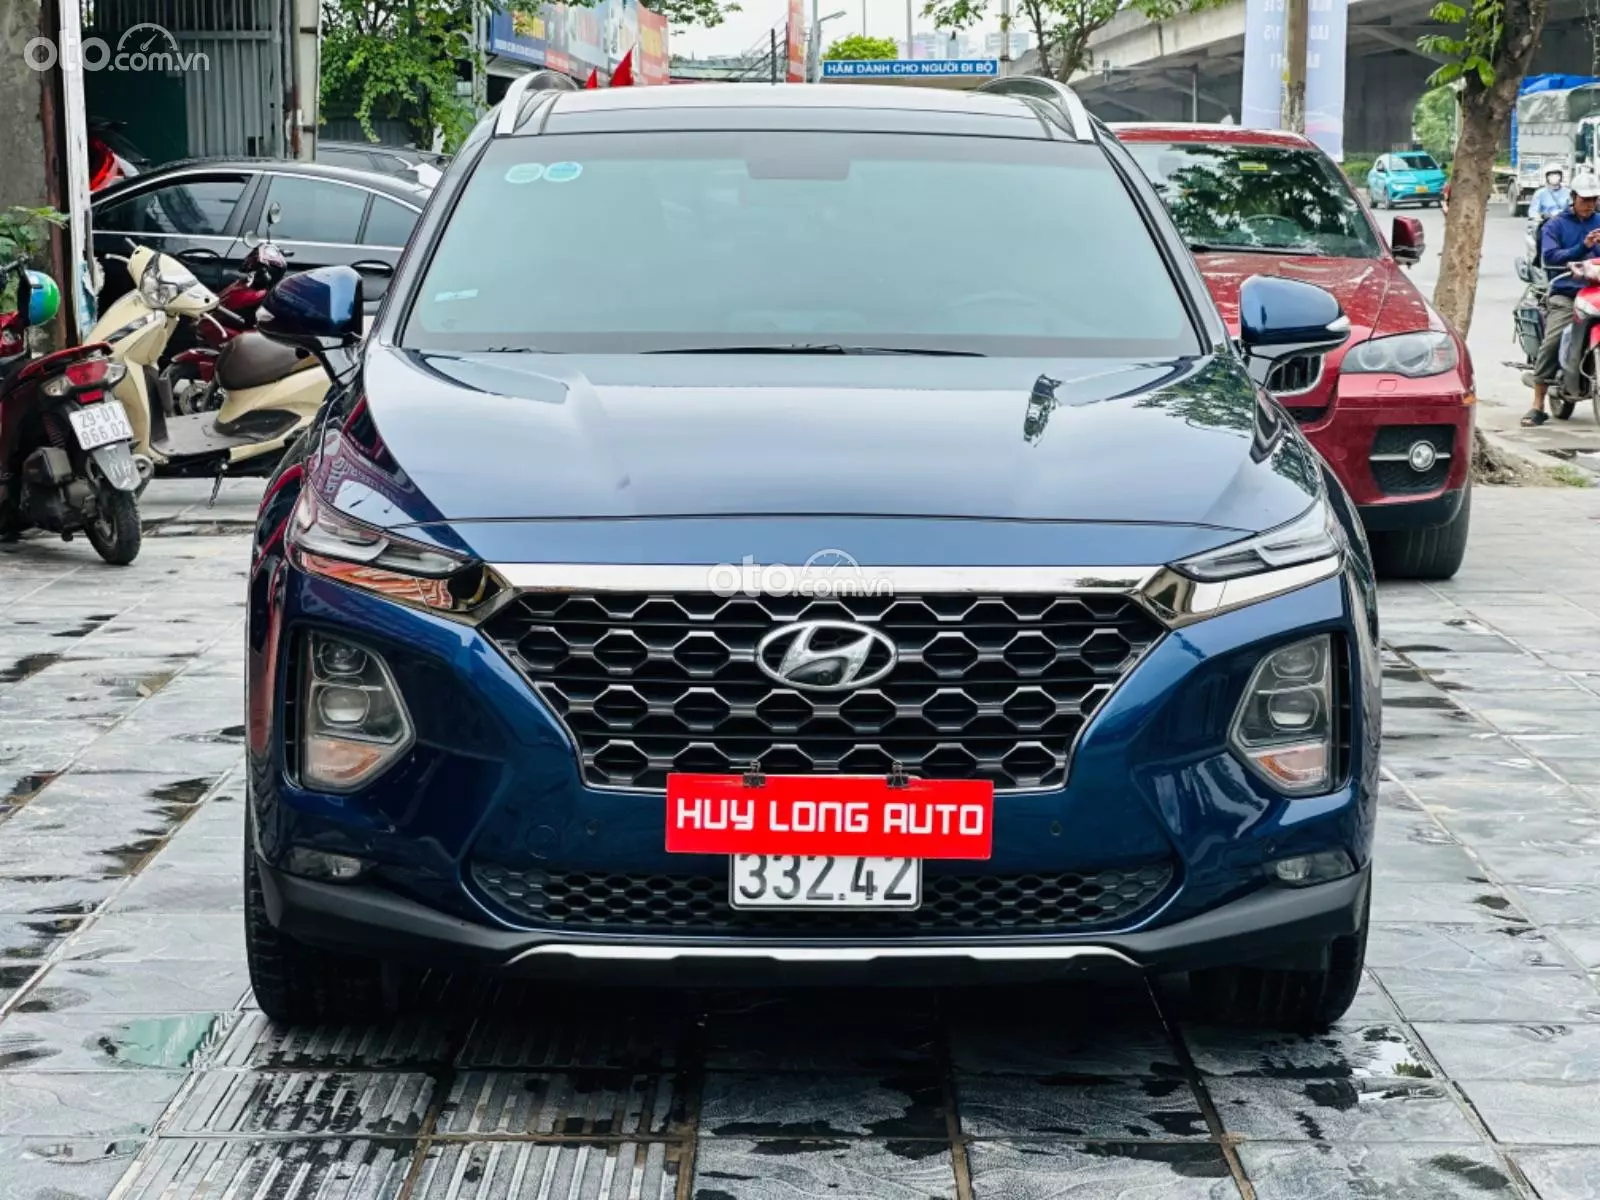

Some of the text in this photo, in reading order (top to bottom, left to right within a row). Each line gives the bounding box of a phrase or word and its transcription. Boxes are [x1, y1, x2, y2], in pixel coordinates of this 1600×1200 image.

[856, 61, 890, 74] DÀNH
[893, 63, 918, 74] CHO
[961, 63, 974, 73] ĐI
[976, 61, 993, 75] BỘ
[676, 798, 984, 836] HUY LONG AUTO
[739, 853, 912, 901] 332.42
